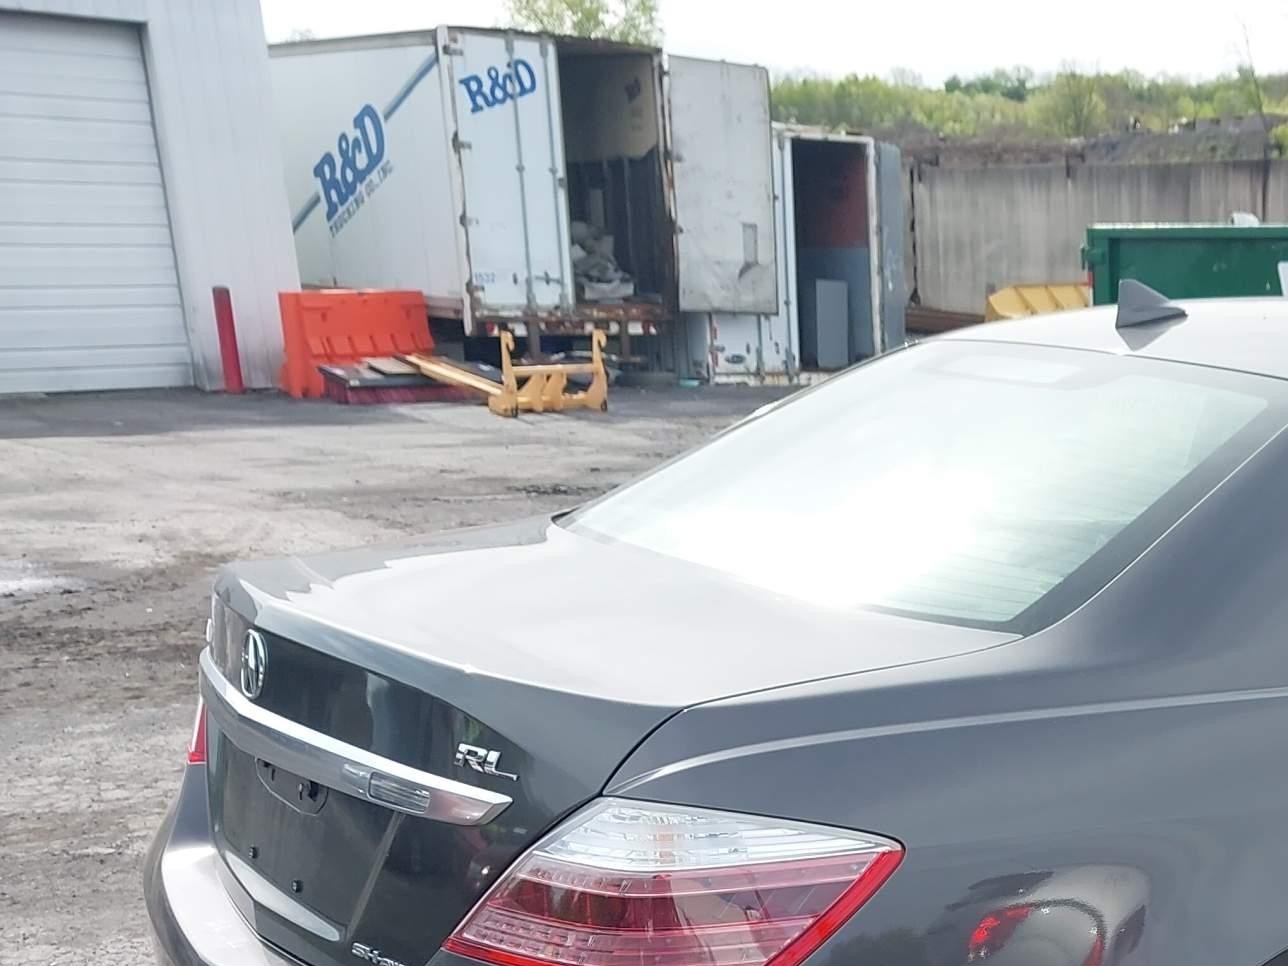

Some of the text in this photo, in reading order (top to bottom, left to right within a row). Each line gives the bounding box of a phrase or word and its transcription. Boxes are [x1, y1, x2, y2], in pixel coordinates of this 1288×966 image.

[459, 59, 536, 112] R&D
[313, 104, 385, 222] R&D
[454, 743, 518, 781] RL
